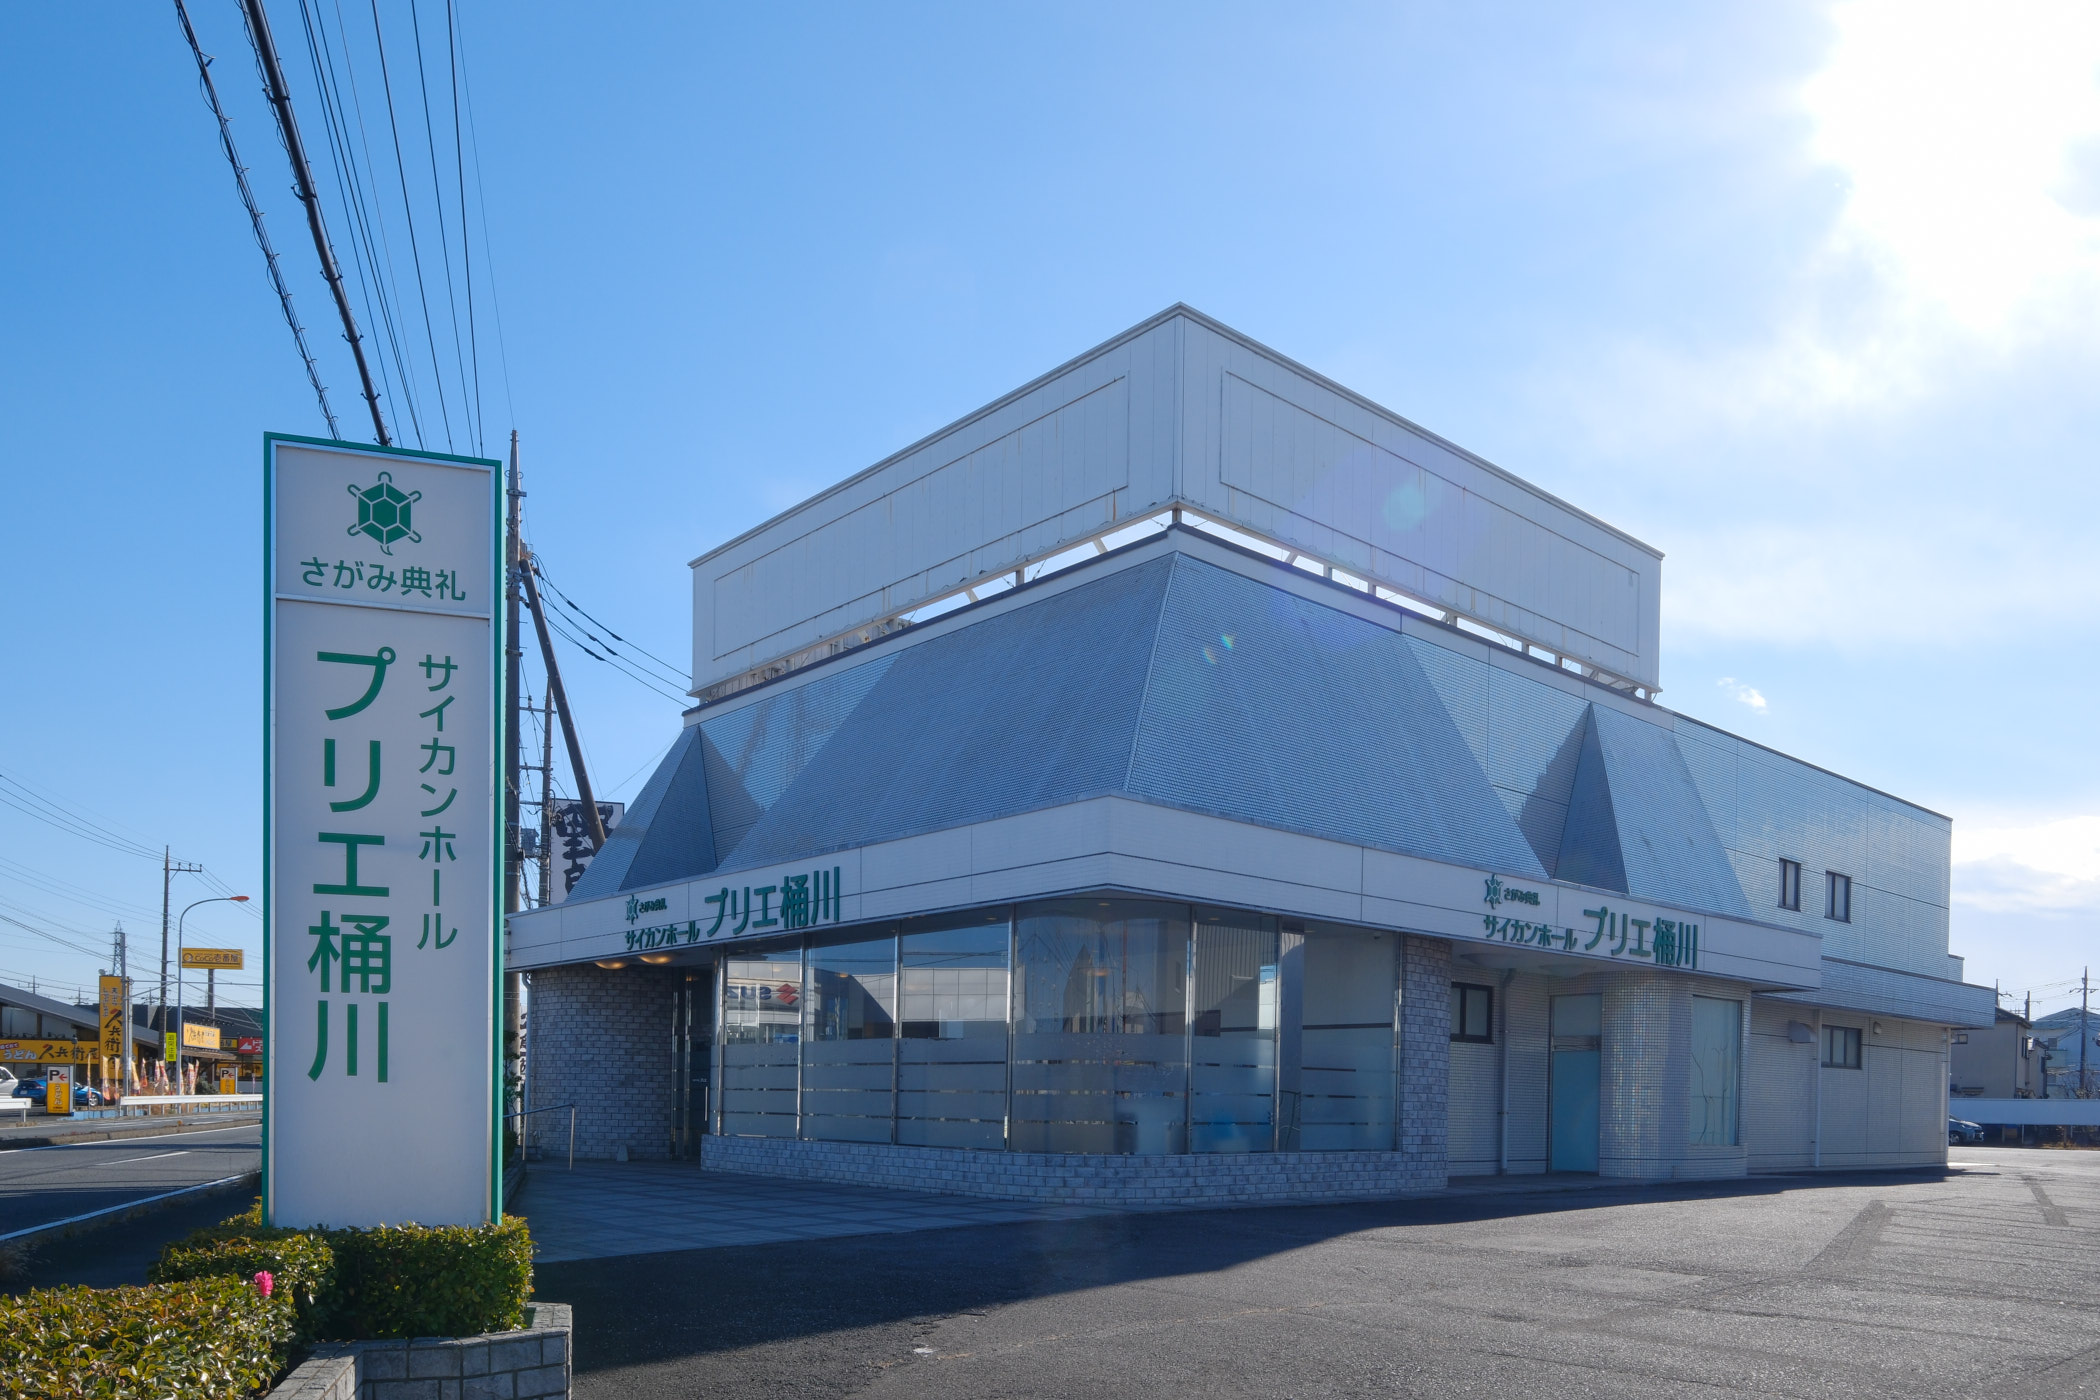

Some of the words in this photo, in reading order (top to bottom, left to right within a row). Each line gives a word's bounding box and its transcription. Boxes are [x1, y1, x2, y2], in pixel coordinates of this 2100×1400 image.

[300, 555, 466, 602] さがみ典礼
[416, 653, 460, 951] サイカンホール
[306, 645, 398, 1084] プリエ桶川
[625, 921, 700, 951] サイカンホール
[704, 866, 841, 938] プリエ桶川
[1483, 914, 1578, 950] サイカンホール
[1584, 906, 1699, 969] プリエ桶川
[3, 1049, 37, 1060] うどん
[49, 1070, 60, 1081] P
[222, 1070, 229, 1078] P
